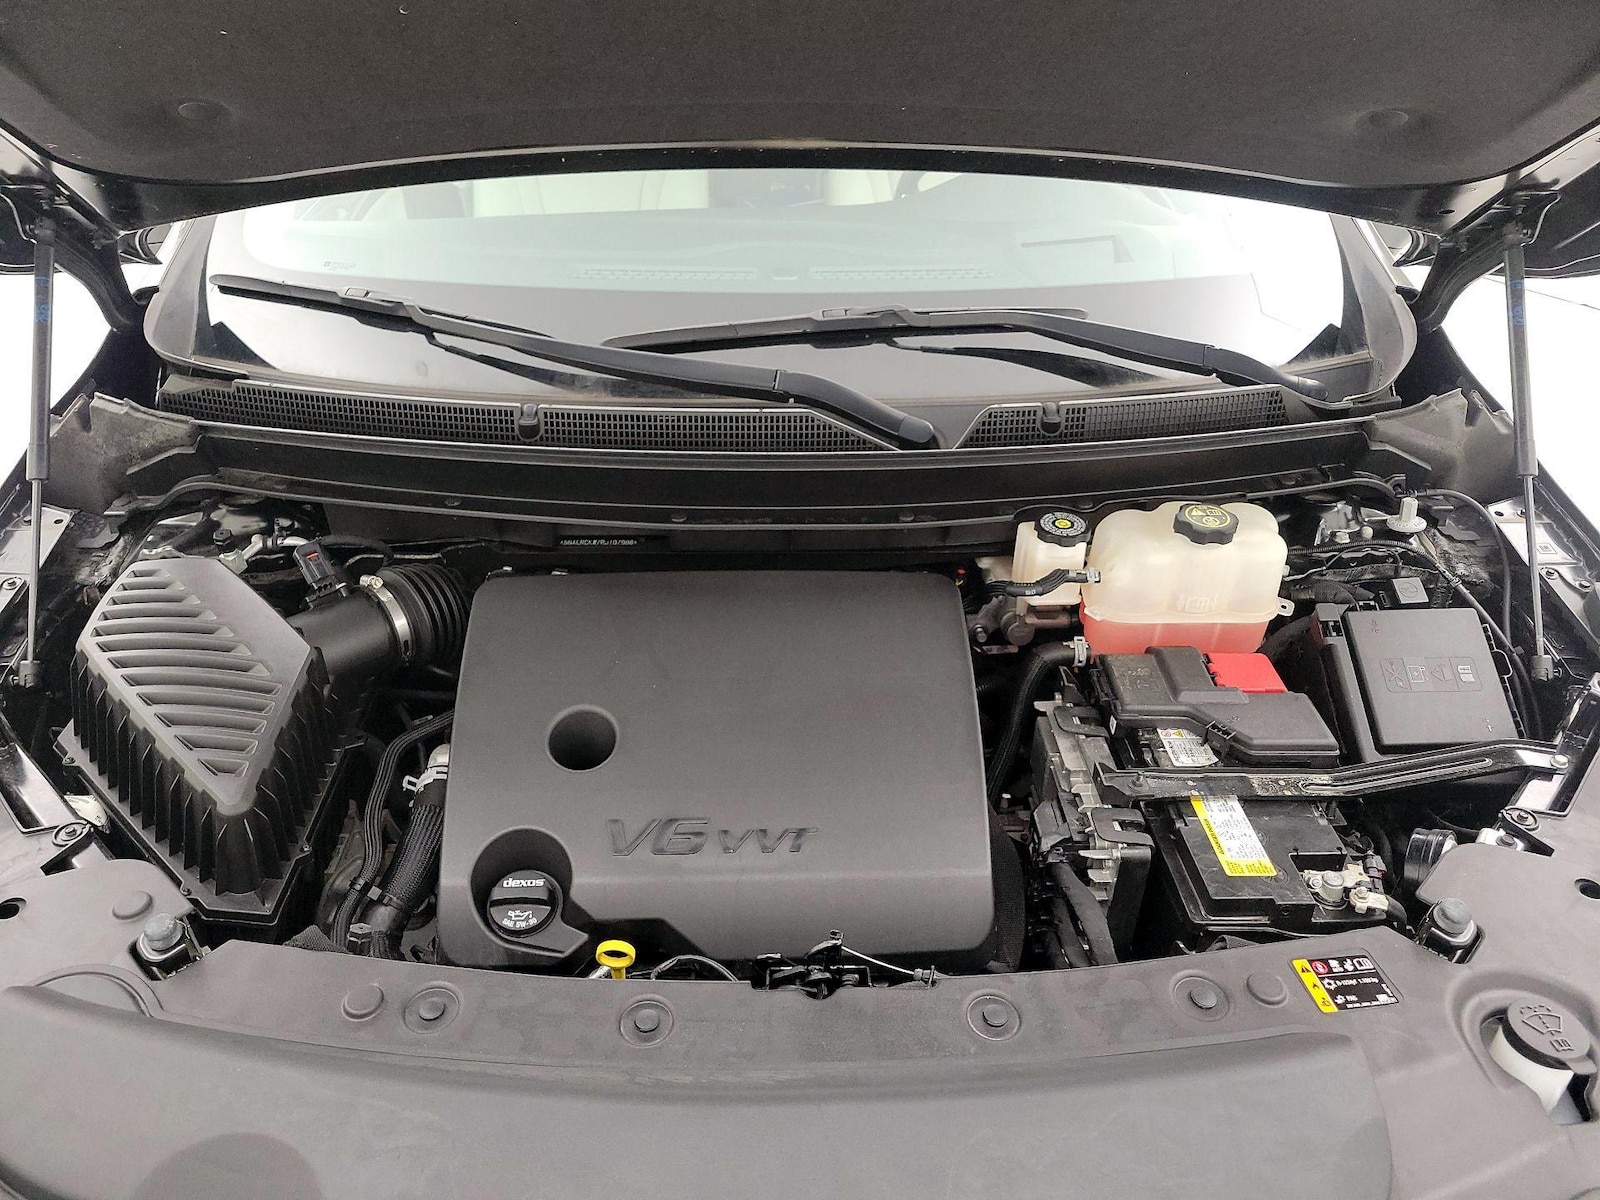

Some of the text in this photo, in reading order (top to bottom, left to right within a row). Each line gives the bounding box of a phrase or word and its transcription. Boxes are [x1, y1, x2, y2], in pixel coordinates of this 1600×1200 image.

[606, 817, 819, 856] V6 VVT
[502, 877, 546, 888] dexos
[502, 917, 537, 928] SAE 5W-30
